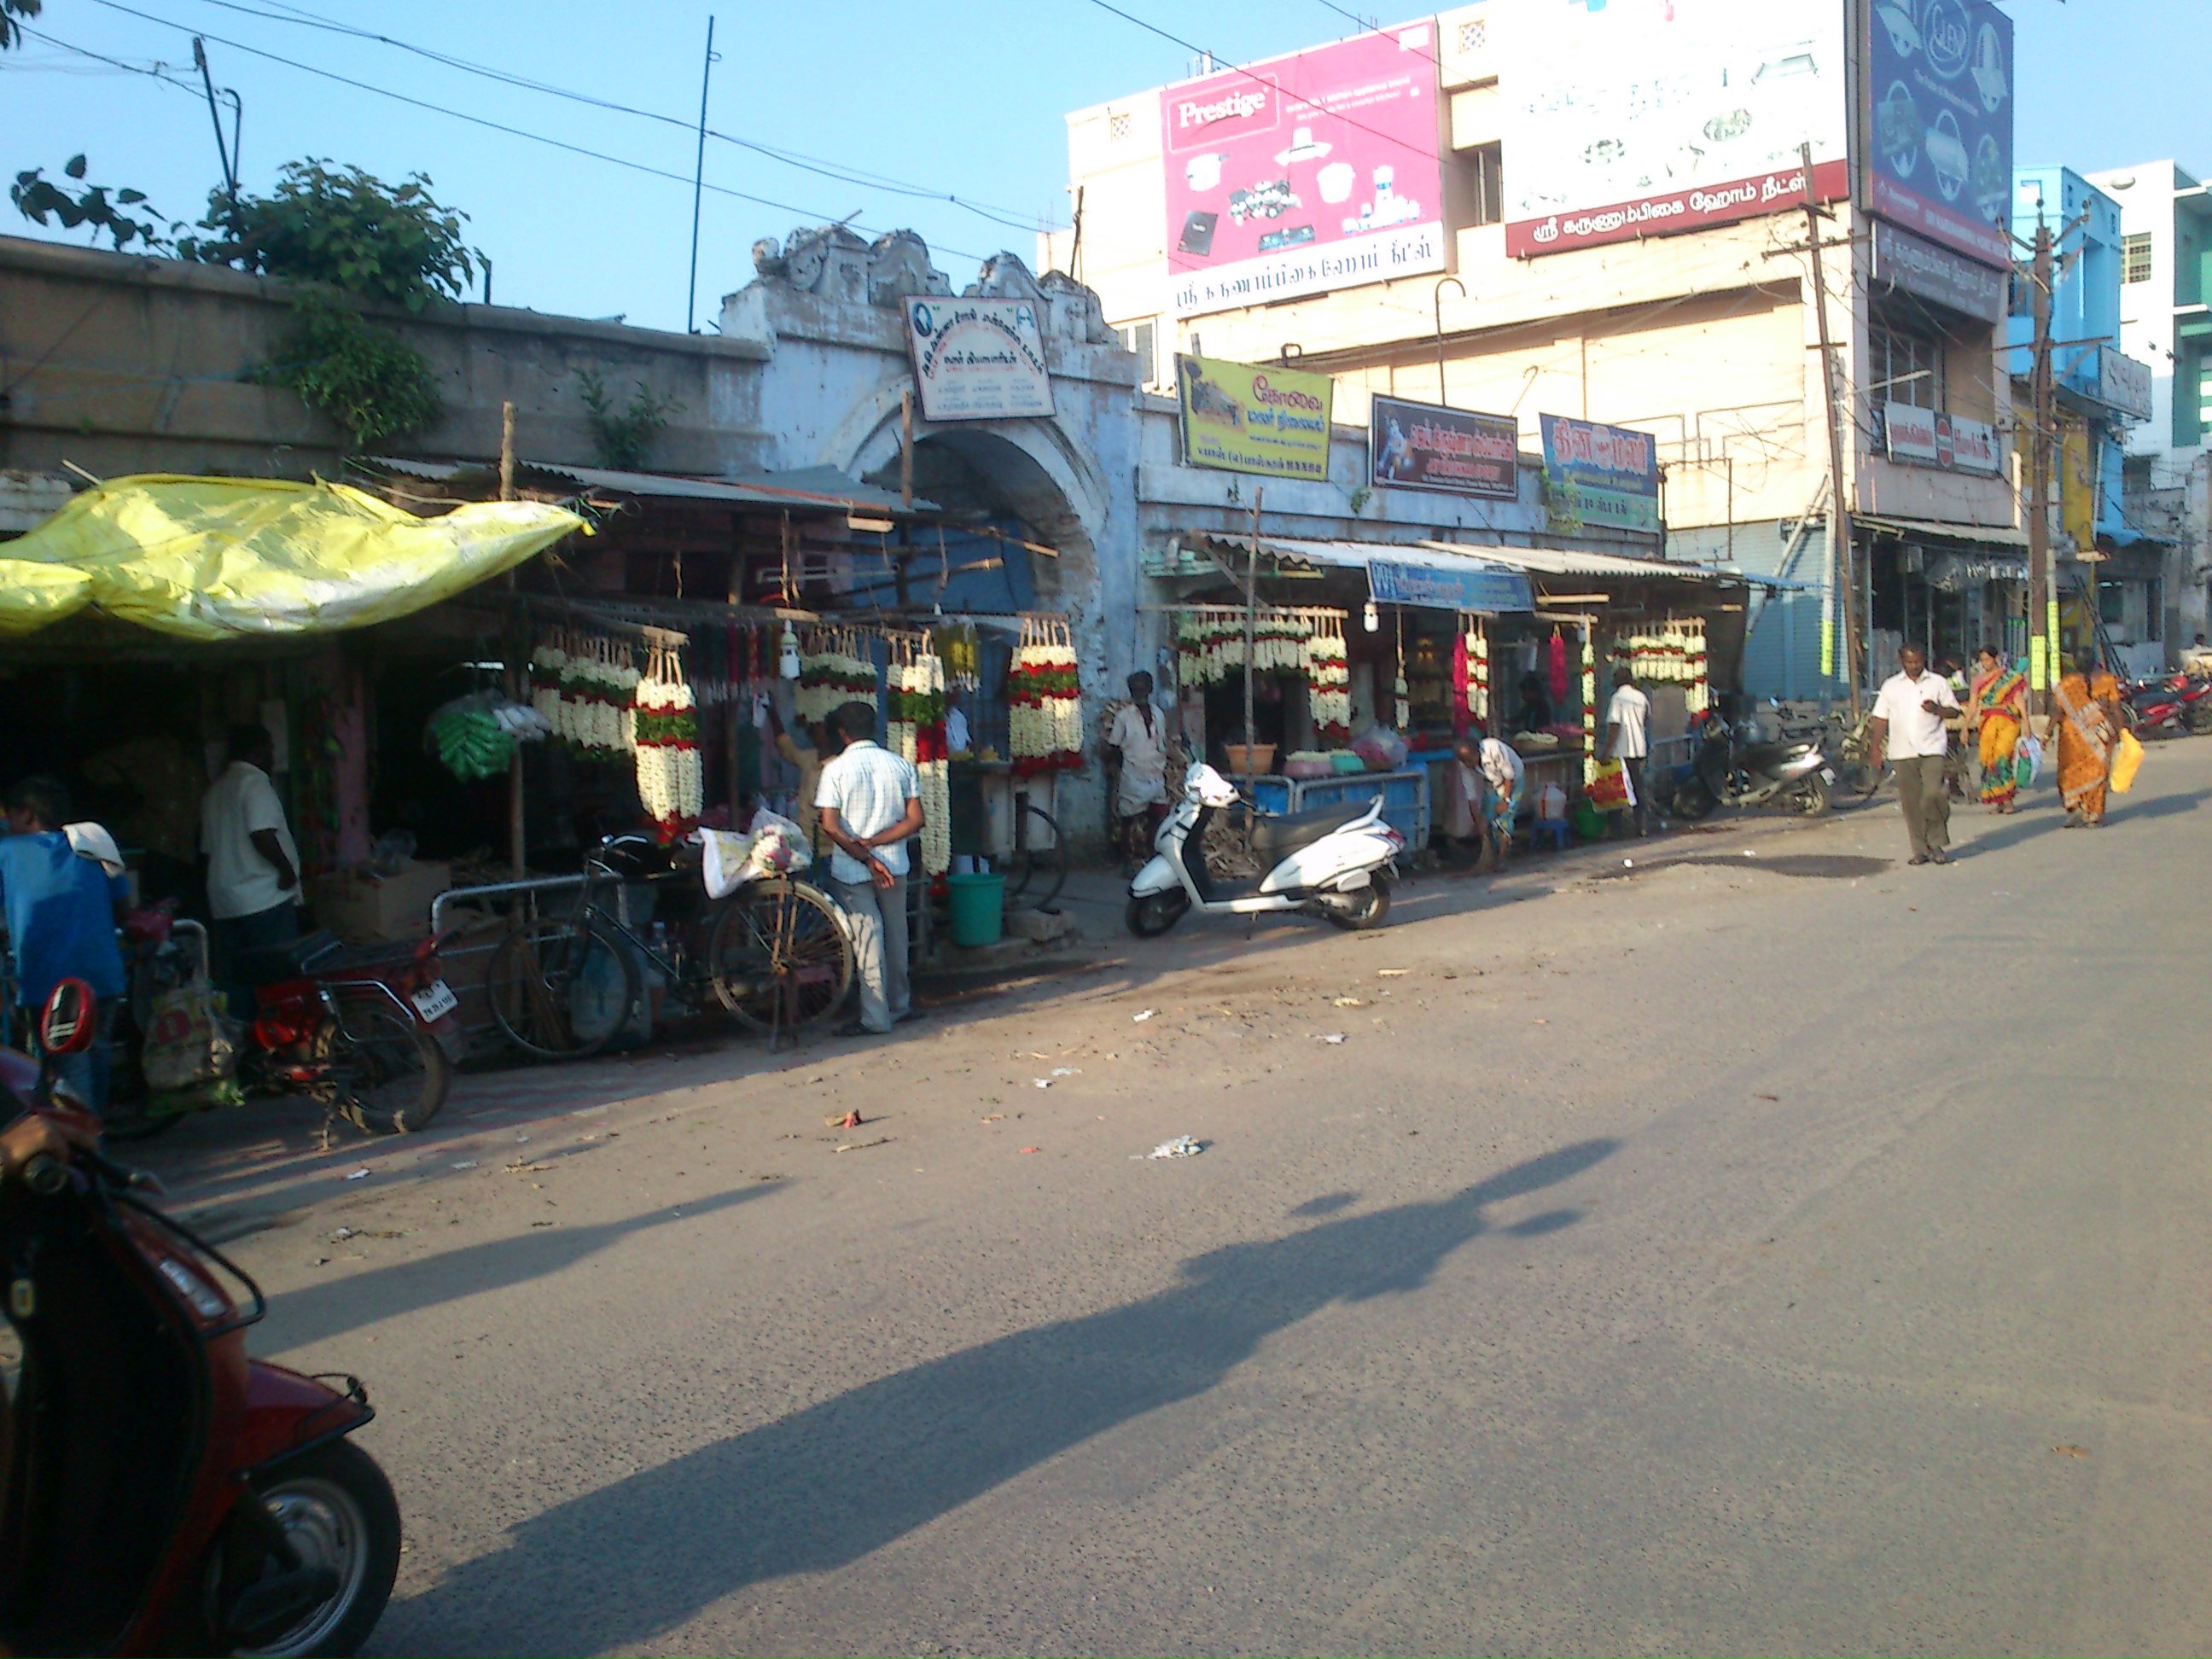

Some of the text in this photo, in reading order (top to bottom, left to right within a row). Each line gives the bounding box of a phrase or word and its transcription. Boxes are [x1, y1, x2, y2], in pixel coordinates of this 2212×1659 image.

[1179, 90, 1266, 128] Prestige
[1253, 375, 1323, 410] கோவை
[1248, 406, 1274, 425] மலர்
